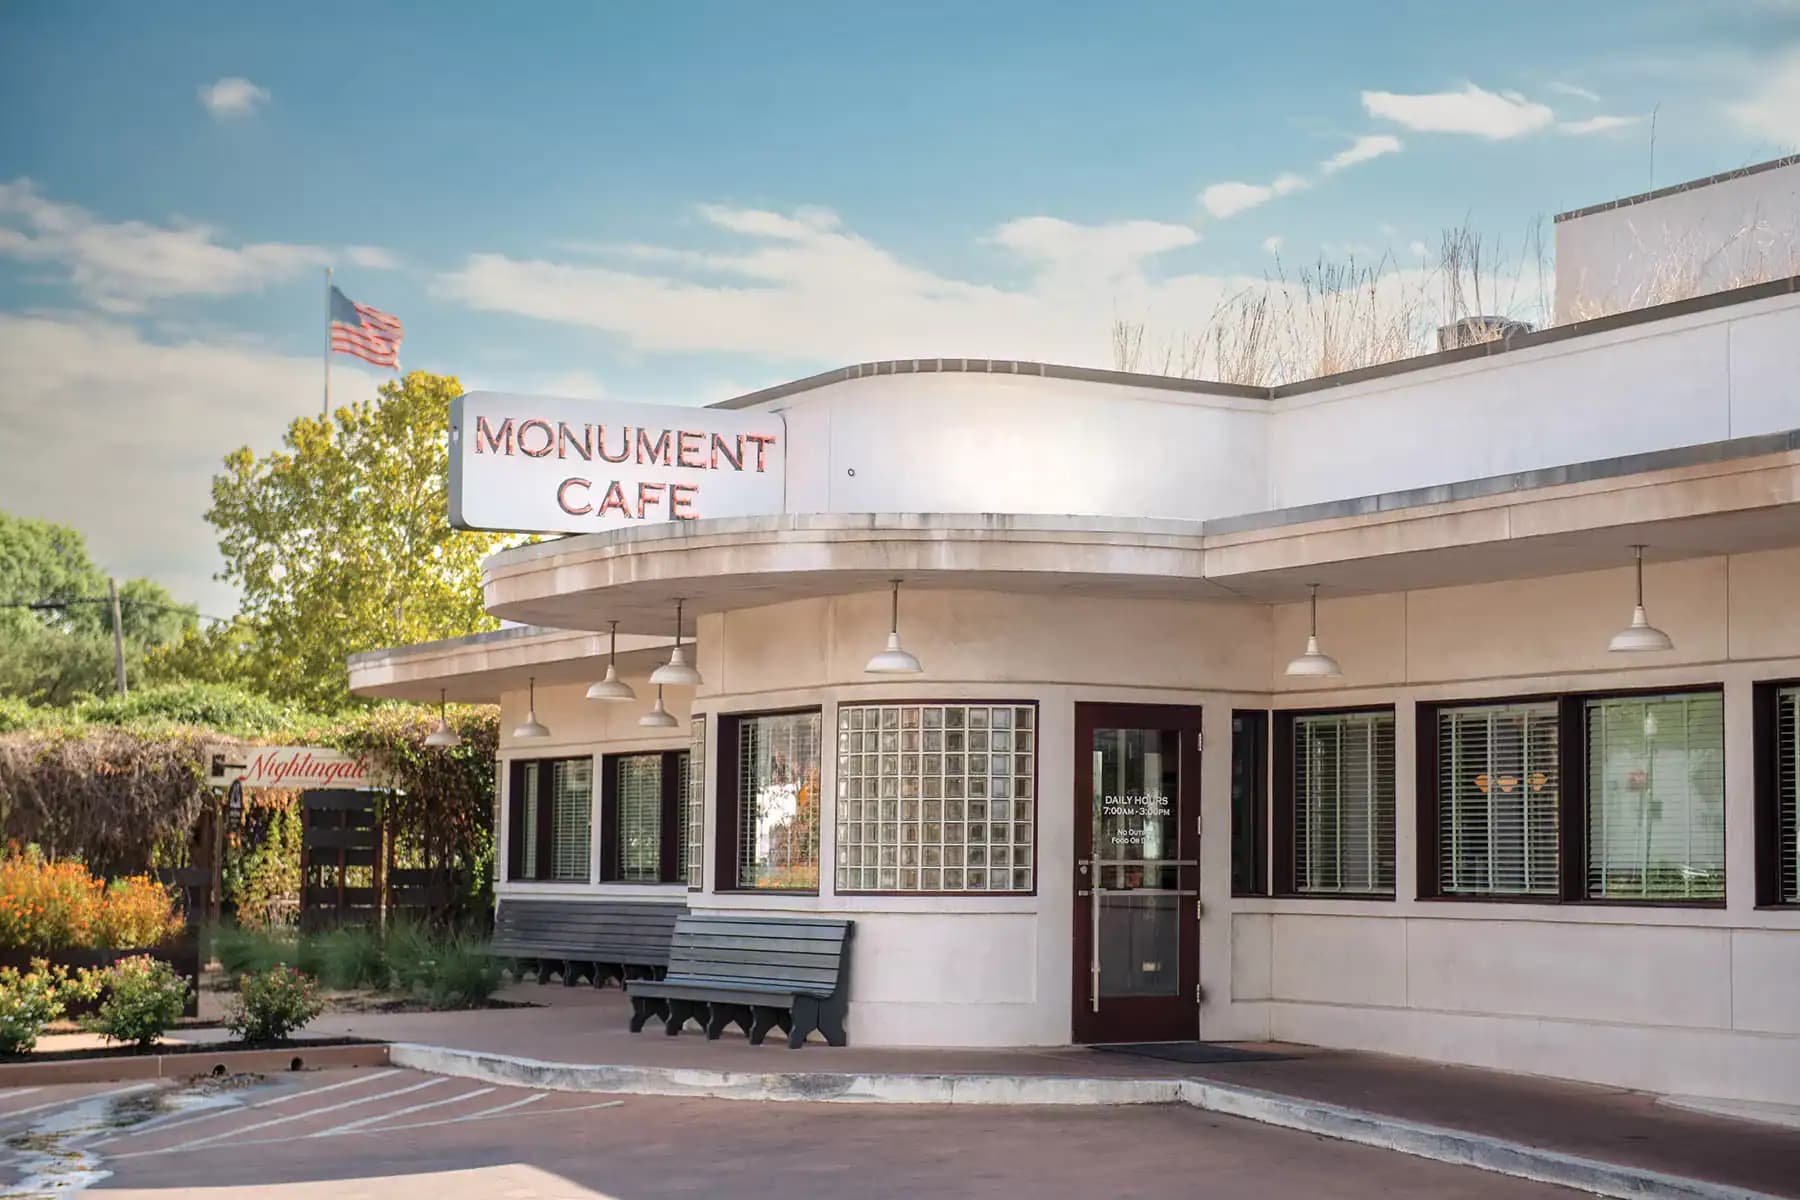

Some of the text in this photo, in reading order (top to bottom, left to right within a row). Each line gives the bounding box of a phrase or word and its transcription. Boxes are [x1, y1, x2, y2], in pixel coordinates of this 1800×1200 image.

[475, 415, 776, 473] MONUMENT
[557, 477, 700, 521] CAFE
[1105, 795, 1169, 806] DAILY HOURS
